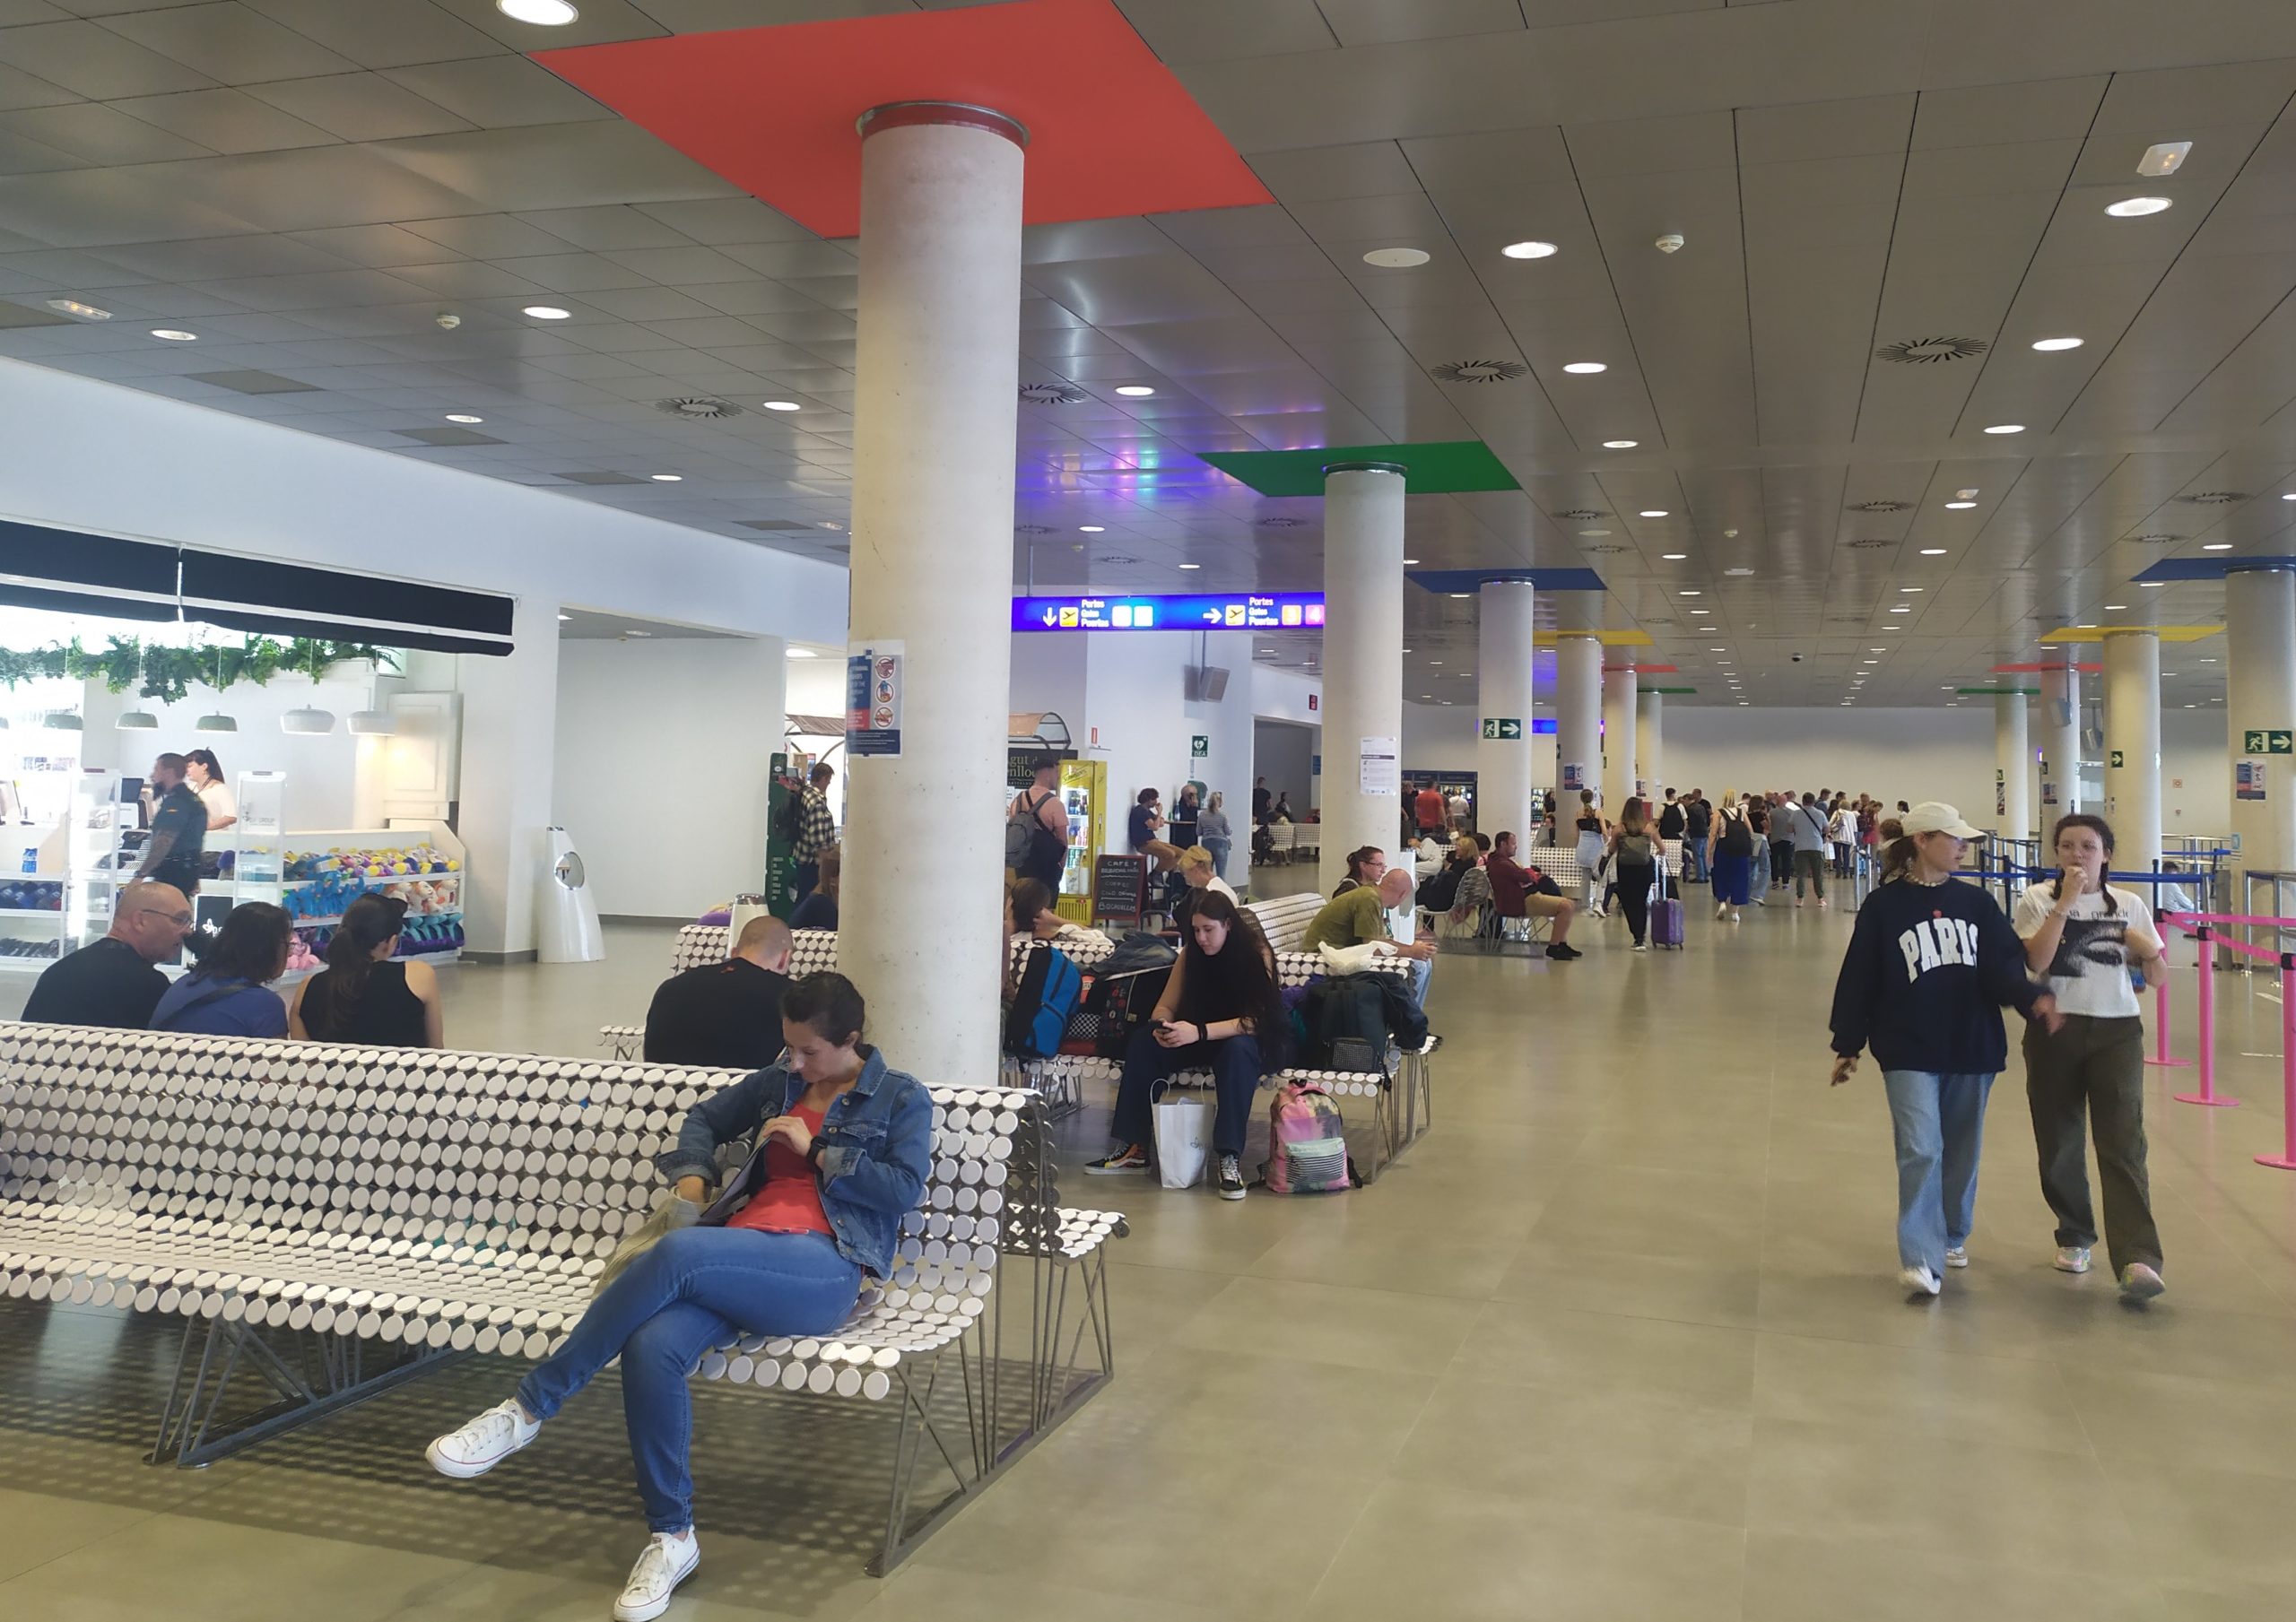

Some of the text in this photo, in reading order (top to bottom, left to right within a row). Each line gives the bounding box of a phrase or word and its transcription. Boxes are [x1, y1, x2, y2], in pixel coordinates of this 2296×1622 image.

[1082, 599, 1105, 608] Portes
[1249, 597, 1274, 606] Portes
[1248, 607, 1267, 616] Gates
[1309, 606, 1321, 622] 4
[1081, 618, 1109, 628] Puertas
[1248, 616, 1278, 626] Puertas
